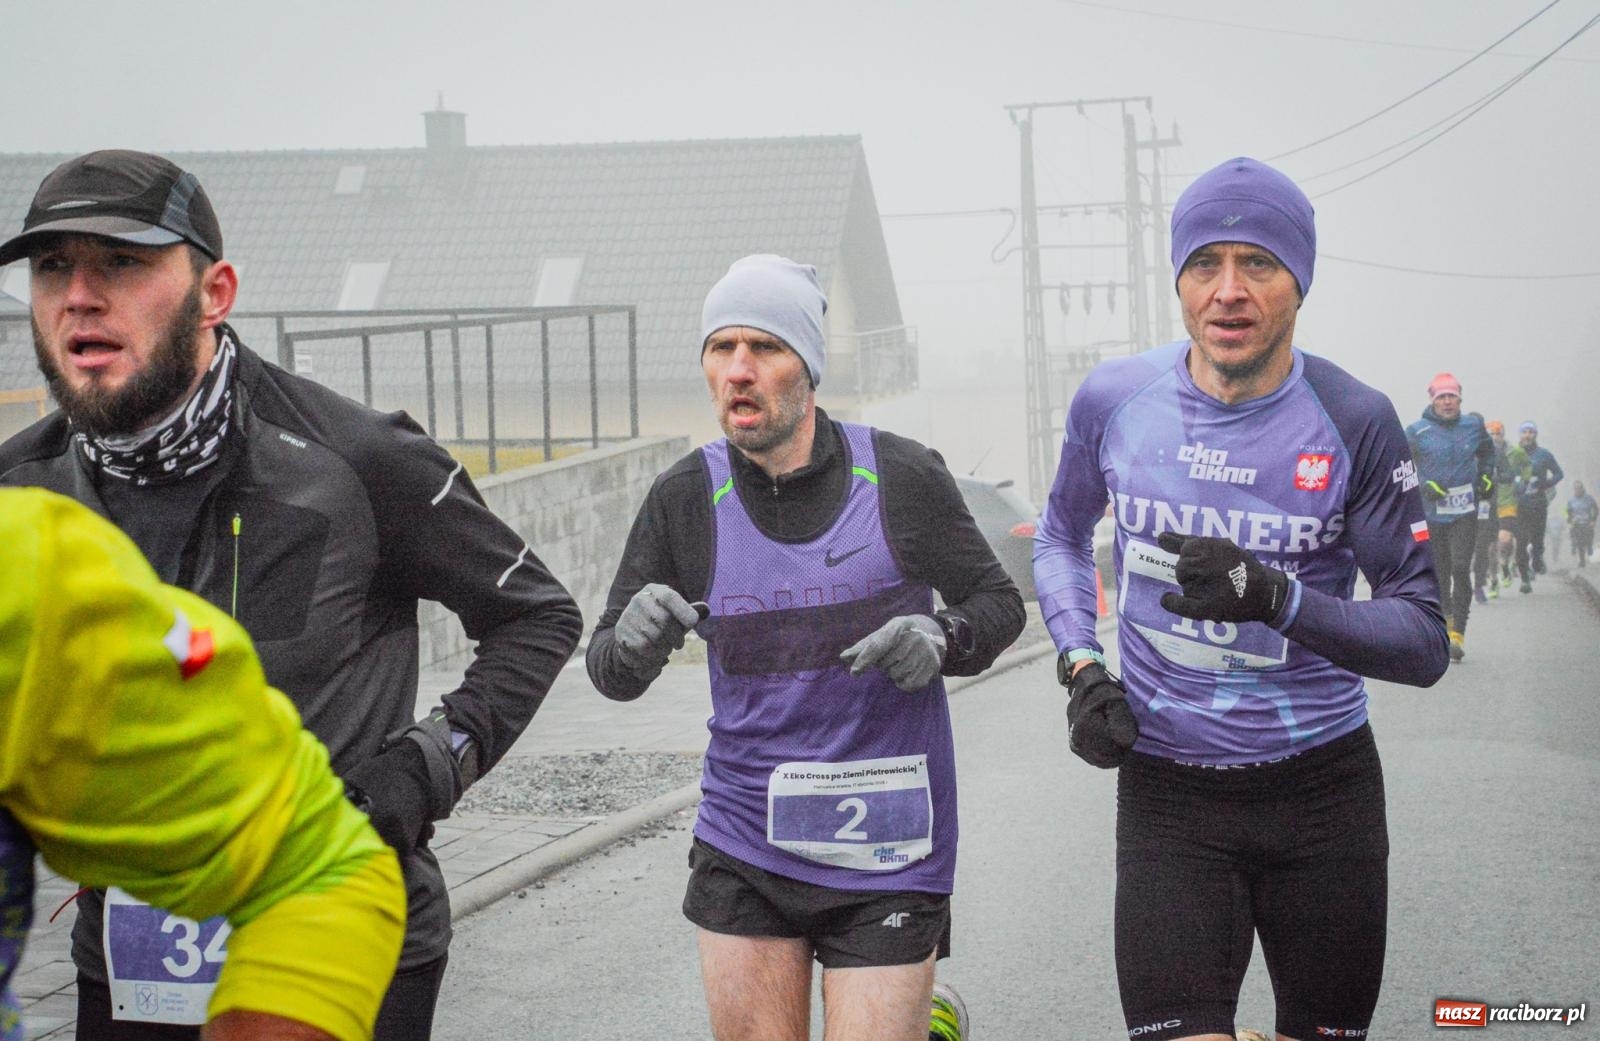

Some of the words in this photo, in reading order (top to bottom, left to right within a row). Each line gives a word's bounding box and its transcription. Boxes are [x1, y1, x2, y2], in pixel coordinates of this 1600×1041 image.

[279, 433, 307, 449] KIPRUN
[1189, 463, 1257, 485] okna
[1146, 556, 1160, 566] Eko
[806, 772, 830, 780] Cross
[831, 773, 841, 782] po
[842, 769, 865, 779] Ziemi
[865, 765, 917, 776] Pietrowickiej
[834, 797, 868, 841] 2
